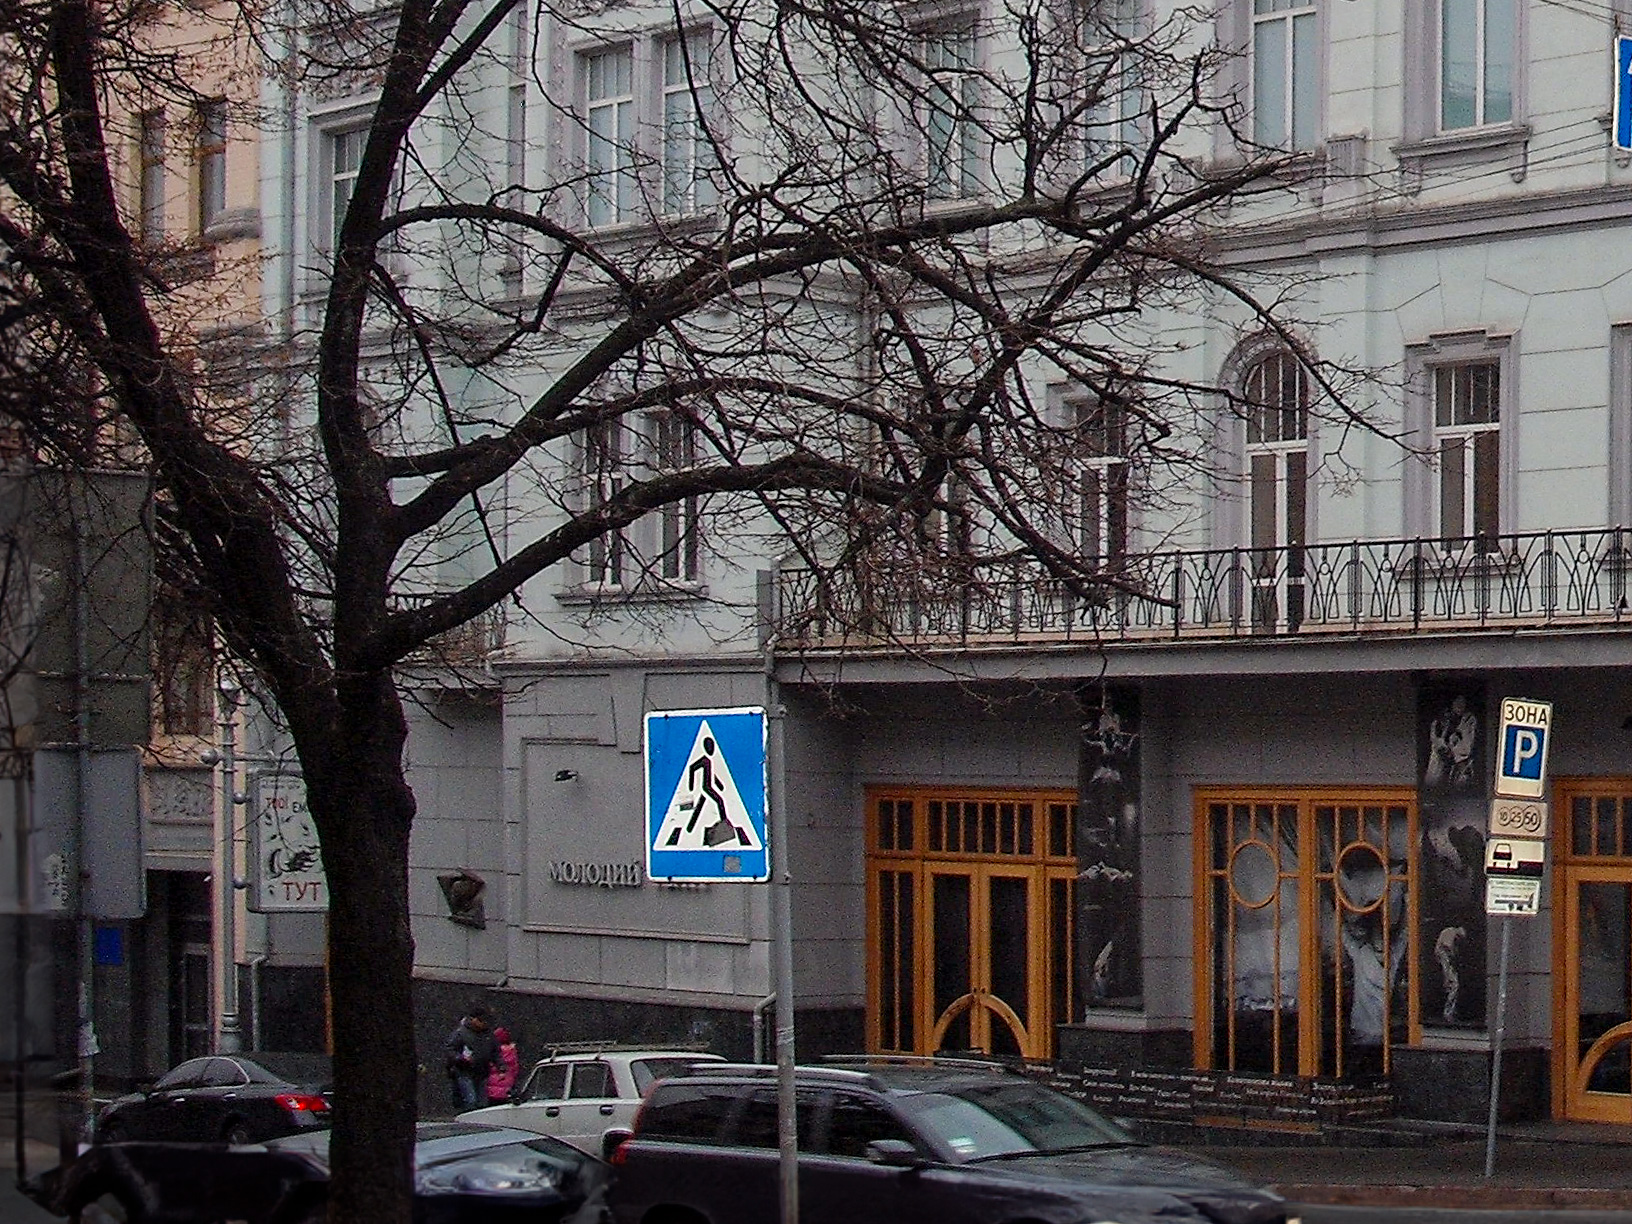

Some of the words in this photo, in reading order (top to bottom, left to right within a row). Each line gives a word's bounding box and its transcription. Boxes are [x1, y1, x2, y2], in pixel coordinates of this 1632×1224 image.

[1505, 704, 1547, 725] ЗОНА
[549, 861, 643, 888] МОЛОДИЙ
[281, 881, 322, 902] ТУТ
